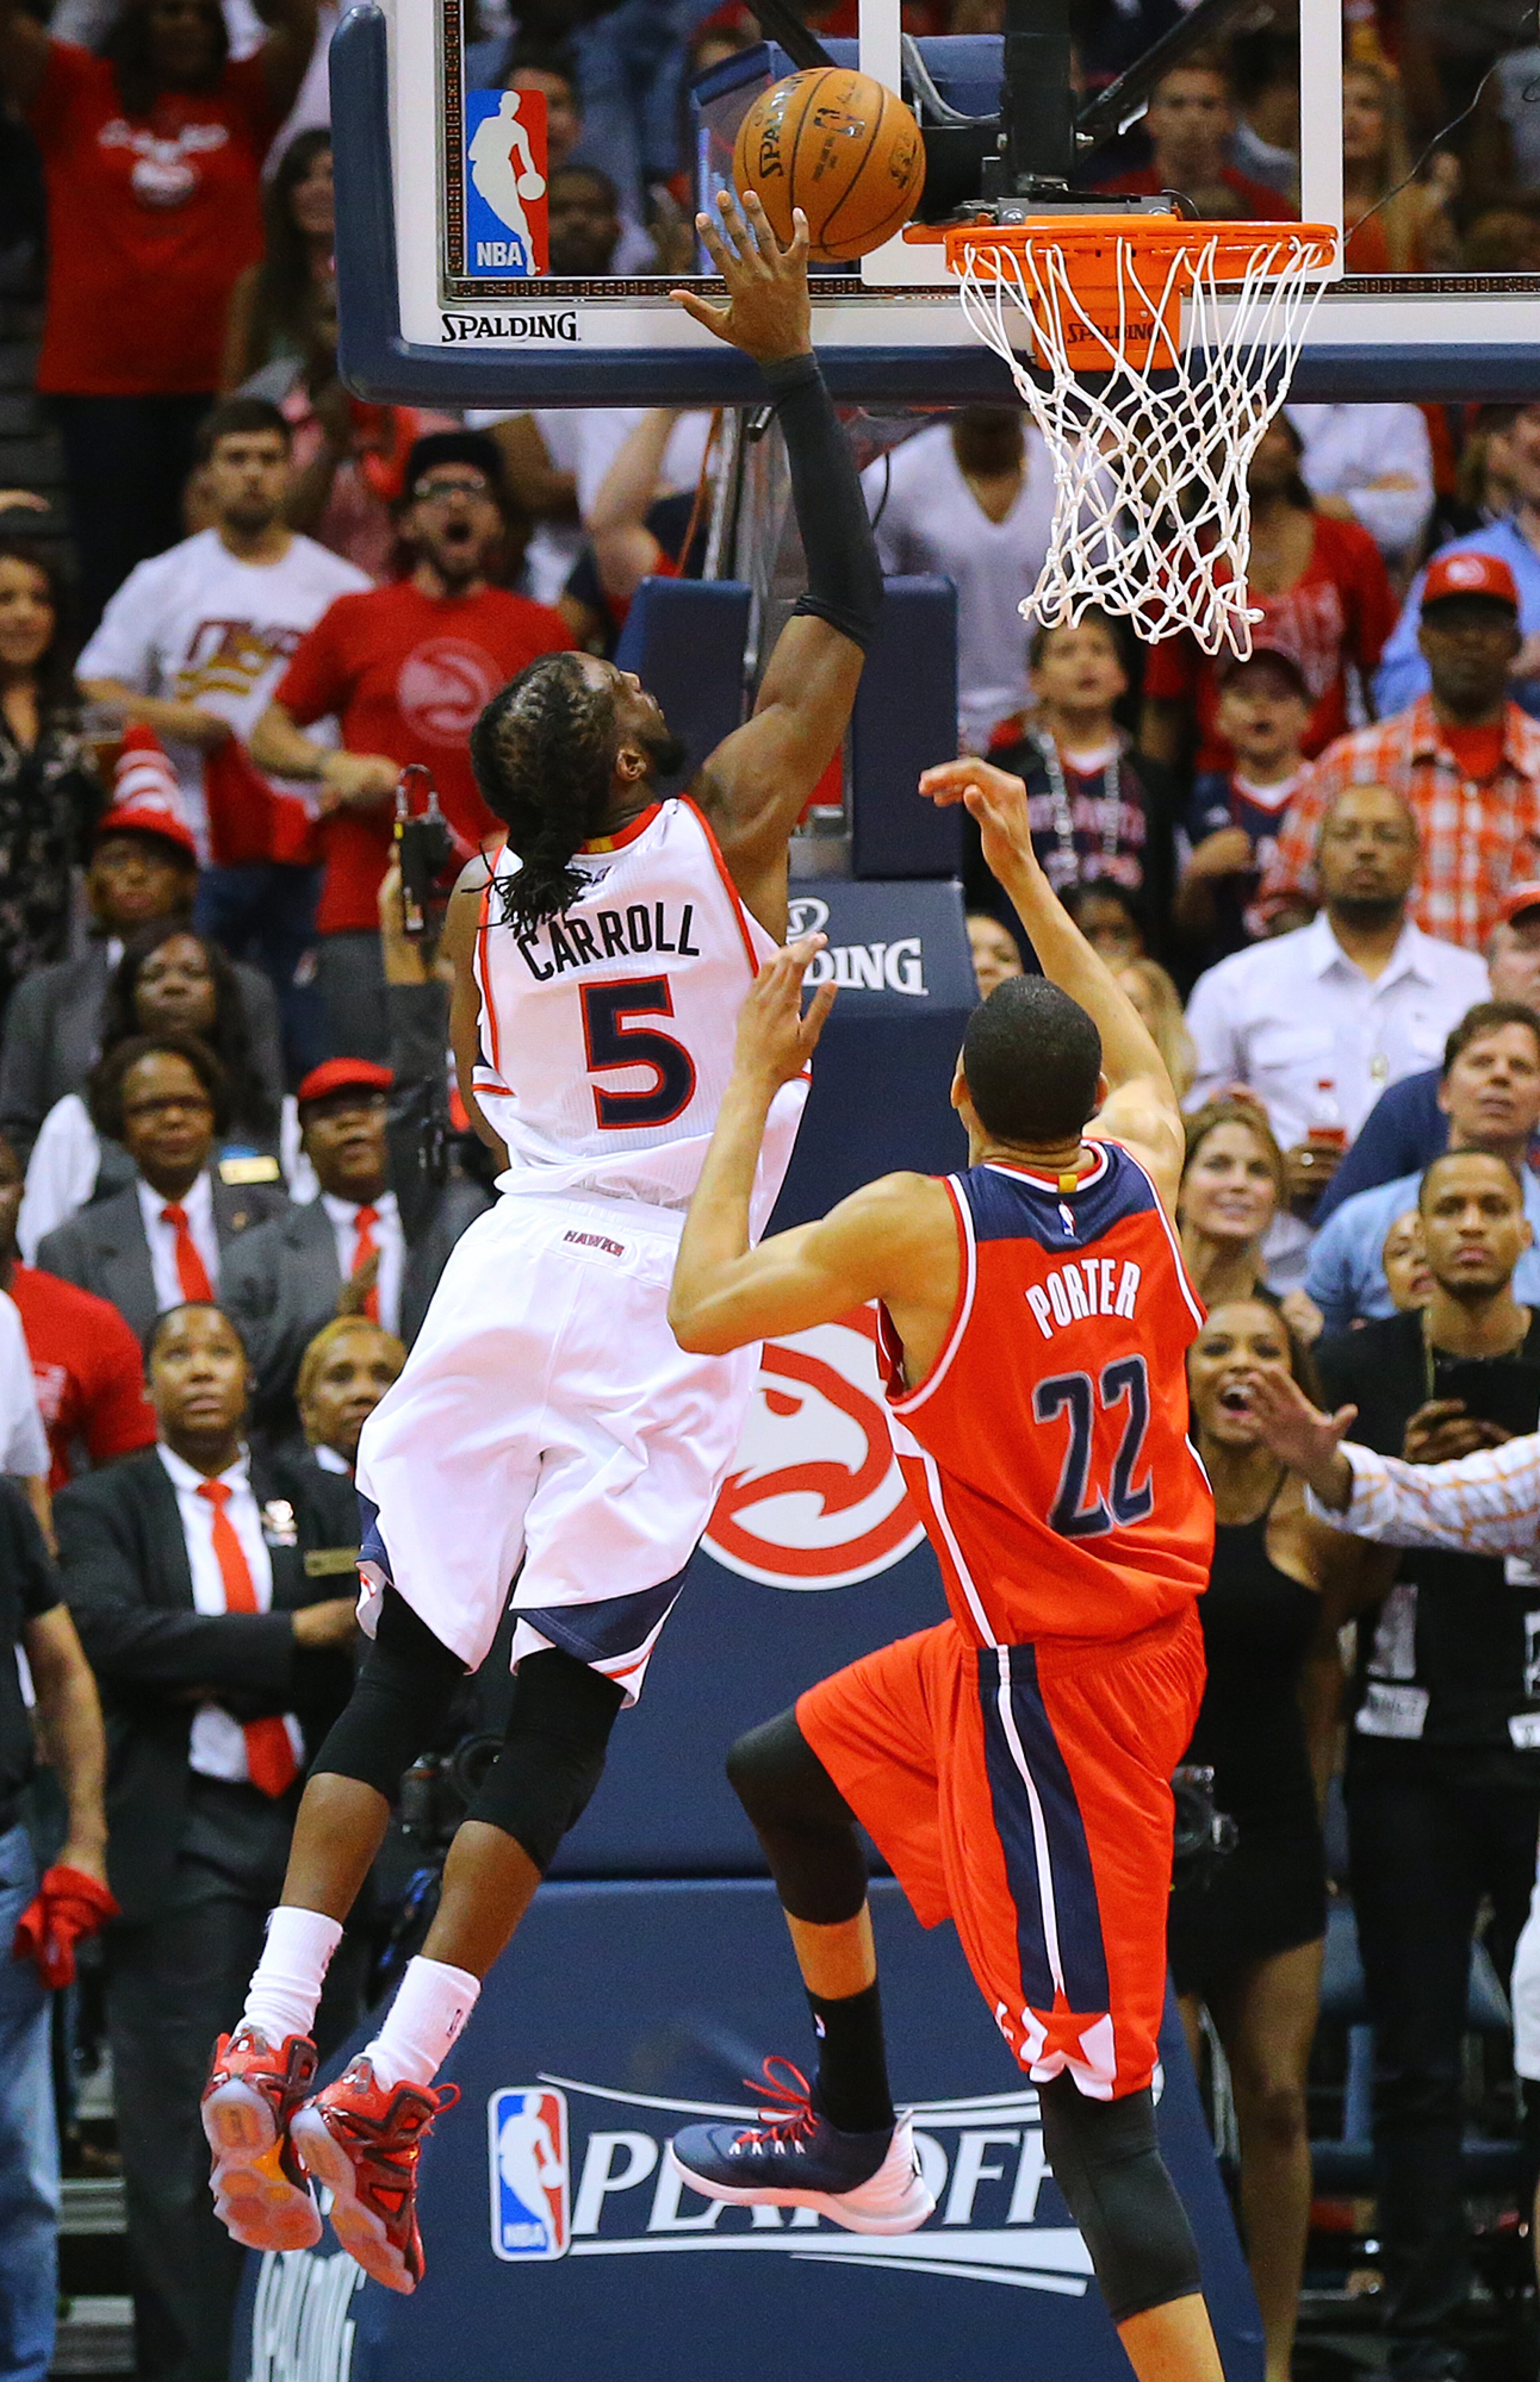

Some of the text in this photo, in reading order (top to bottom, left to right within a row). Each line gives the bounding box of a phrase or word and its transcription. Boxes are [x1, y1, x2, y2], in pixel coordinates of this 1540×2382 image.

[476, 242, 523, 266] NBA
[442, 312, 576, 342] SPALDING
[517, 902, 699, 981] CARROLL
[578, 974, 696, 1129] 5
[563, 1230, 624, 1257] HAWKS
[1025, 1258, 1141, 1339] PORTER
[1031, 1353, 1153, 1540] 22
